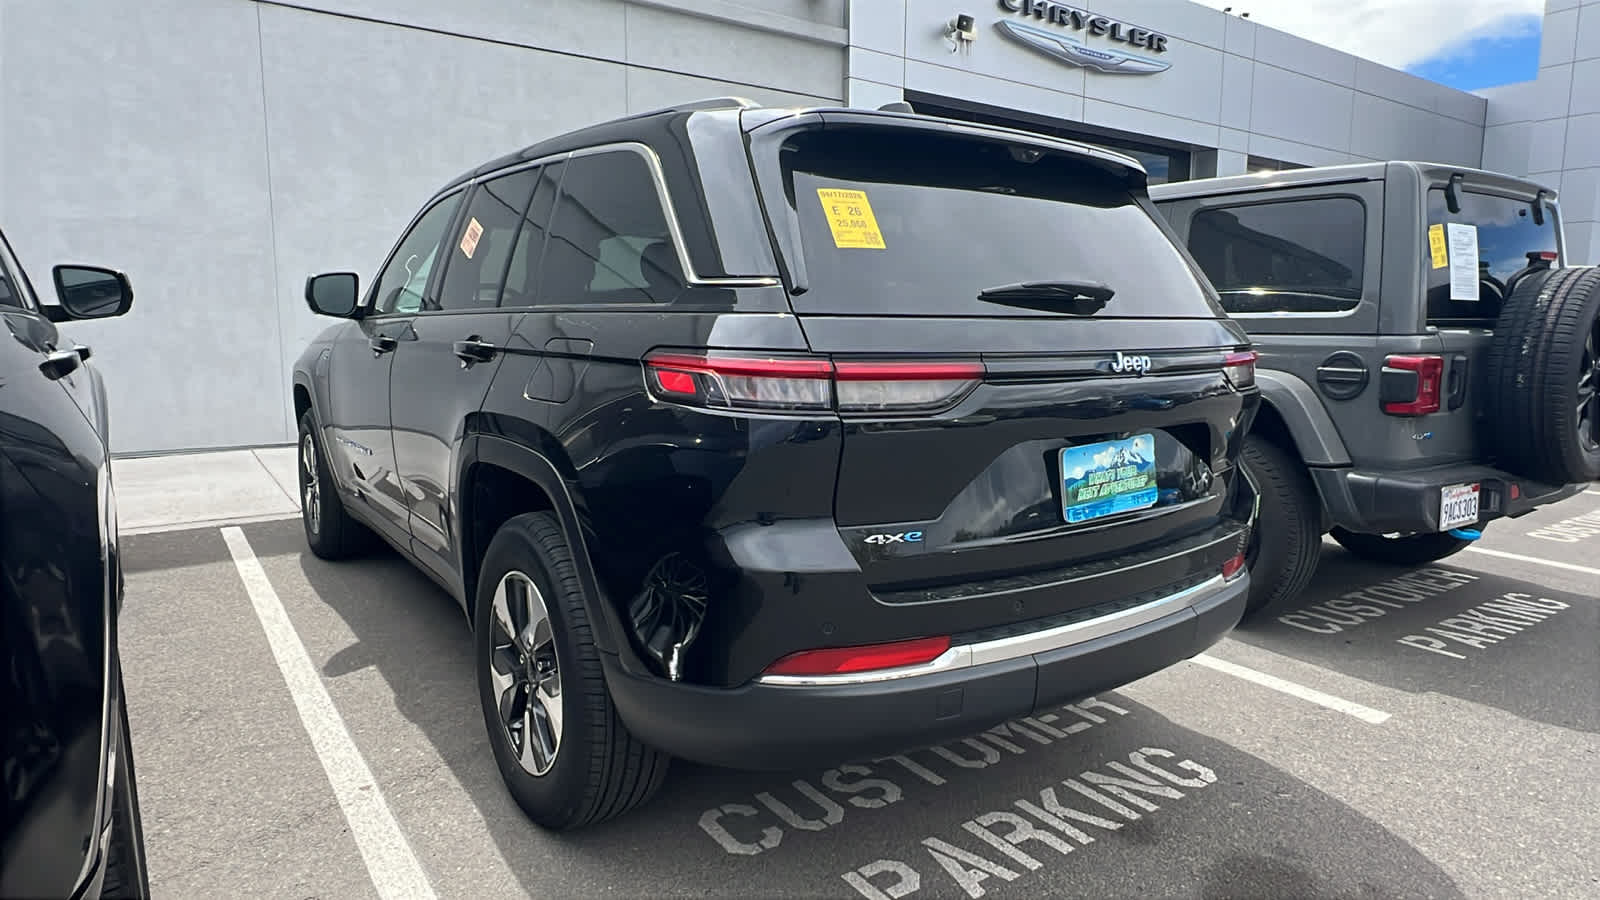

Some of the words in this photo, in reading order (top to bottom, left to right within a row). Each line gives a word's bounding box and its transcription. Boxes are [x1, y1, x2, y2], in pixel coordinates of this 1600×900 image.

[997, 0, 1168, 51] CHRYSLER
[832, 206, 840, 216] E
[847, 207, 862, 216] 26
[1111, 351, 1152, 376] Jeep
[1443, 497, 1477, 523] 9ACS303
[1278, 567, 1480, 634] CUSTOMER
[1396, 591, 1571, 659] PARKING
[841, 747, 1217, 900] PARKING
